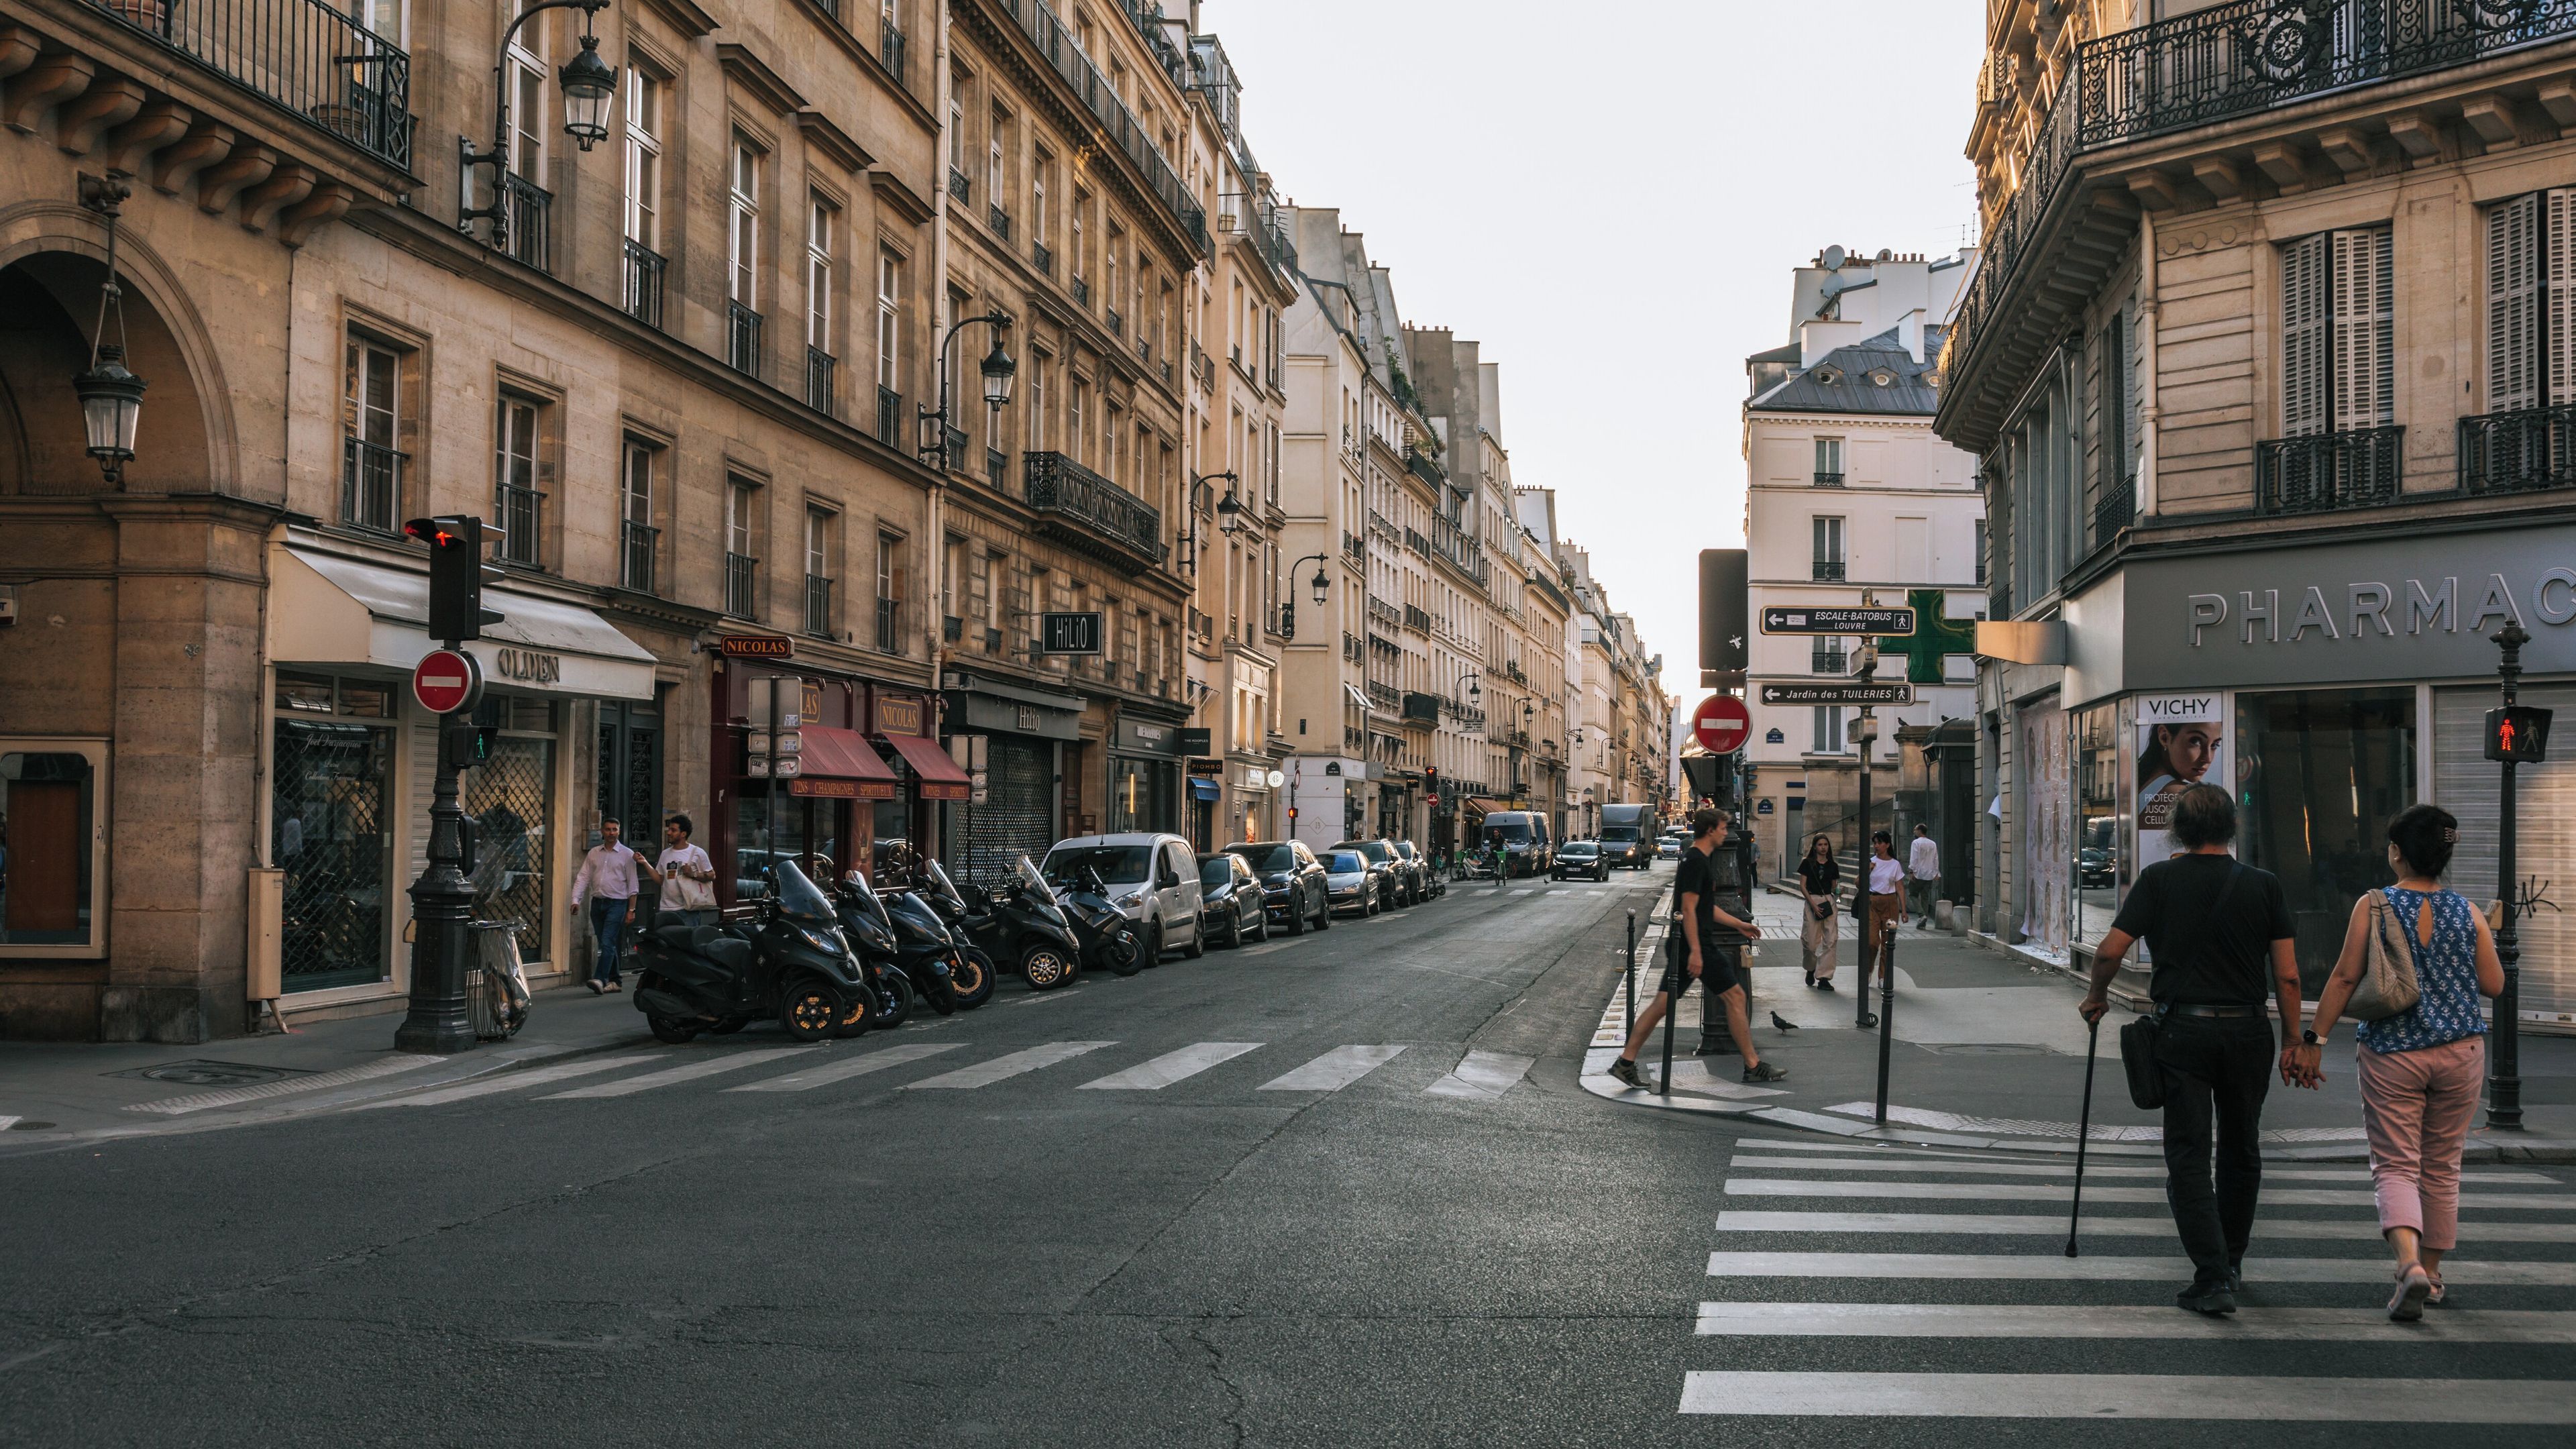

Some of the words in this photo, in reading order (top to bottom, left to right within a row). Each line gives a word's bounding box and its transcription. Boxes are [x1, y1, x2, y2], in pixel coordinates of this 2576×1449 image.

[2188, 567, 2576, 647] PHARMAC
[1815, 611, 1892, 621] ESCALE-BATOBUS
[1834, 622, 1866, 630] LOUVRE
[727, 641, 786, 653] NICOLAS
[498, 648, 560, 682] OLDEN
[1786, 690, 1817, 698] Jardin
[1821, 690, 1837, 698] des
[1842, 690, 1892, 698] TUILERIES
[2149, 698, 2211, 715] VICHY
[882, 705, 917, 729] NICOLAS
[1018, 705, 1040, 731] Hilio
[794, 780, 808, 794] VINS
[814, 782, 854, 795] CHAMPAGNES
[860, 784, 892, 796] SPIRITUEUX
[925, 785, 940, 796] WINES
[949, 786, 965, 797] SPIRITS
